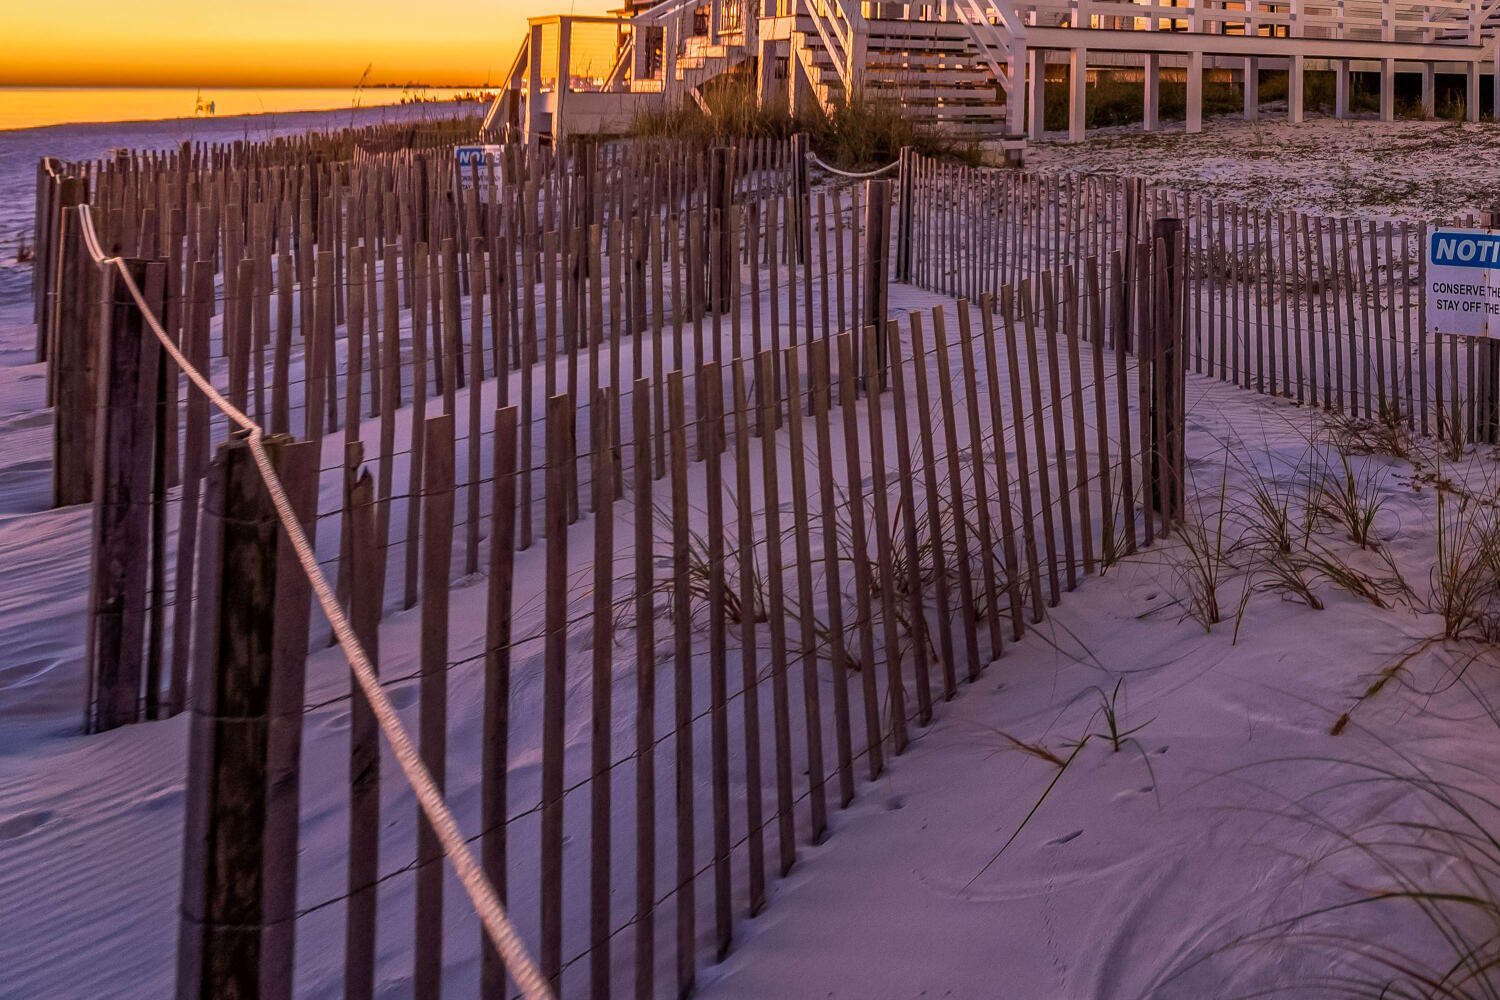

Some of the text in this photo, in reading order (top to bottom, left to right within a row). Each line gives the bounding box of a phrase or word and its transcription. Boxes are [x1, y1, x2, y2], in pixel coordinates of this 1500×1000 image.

[1432, 282, 1485, 296] CONSERVE
[1436, 299, 1460, 311] STAY
[1462, 301, 1482, 313] OFF
[1484, 302, 1500, 315] THE
